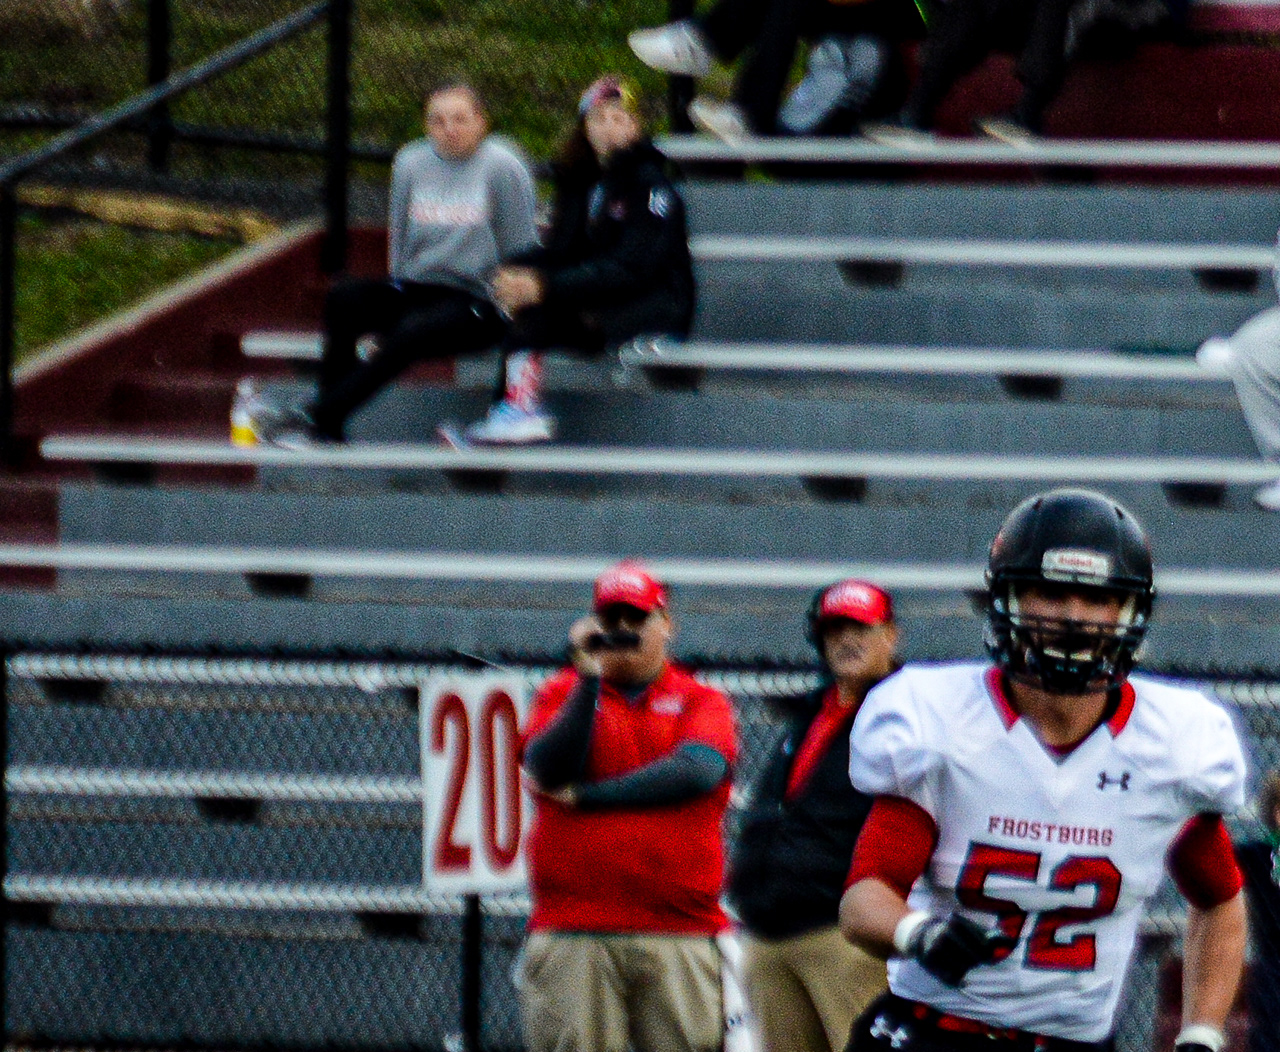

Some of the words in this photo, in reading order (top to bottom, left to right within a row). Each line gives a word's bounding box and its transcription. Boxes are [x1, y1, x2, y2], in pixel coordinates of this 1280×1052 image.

[431, 691, 523, 874] 20
[987, 815, 1115, 848] FROSTBURG
[954, 839, 1123, 973] 52
